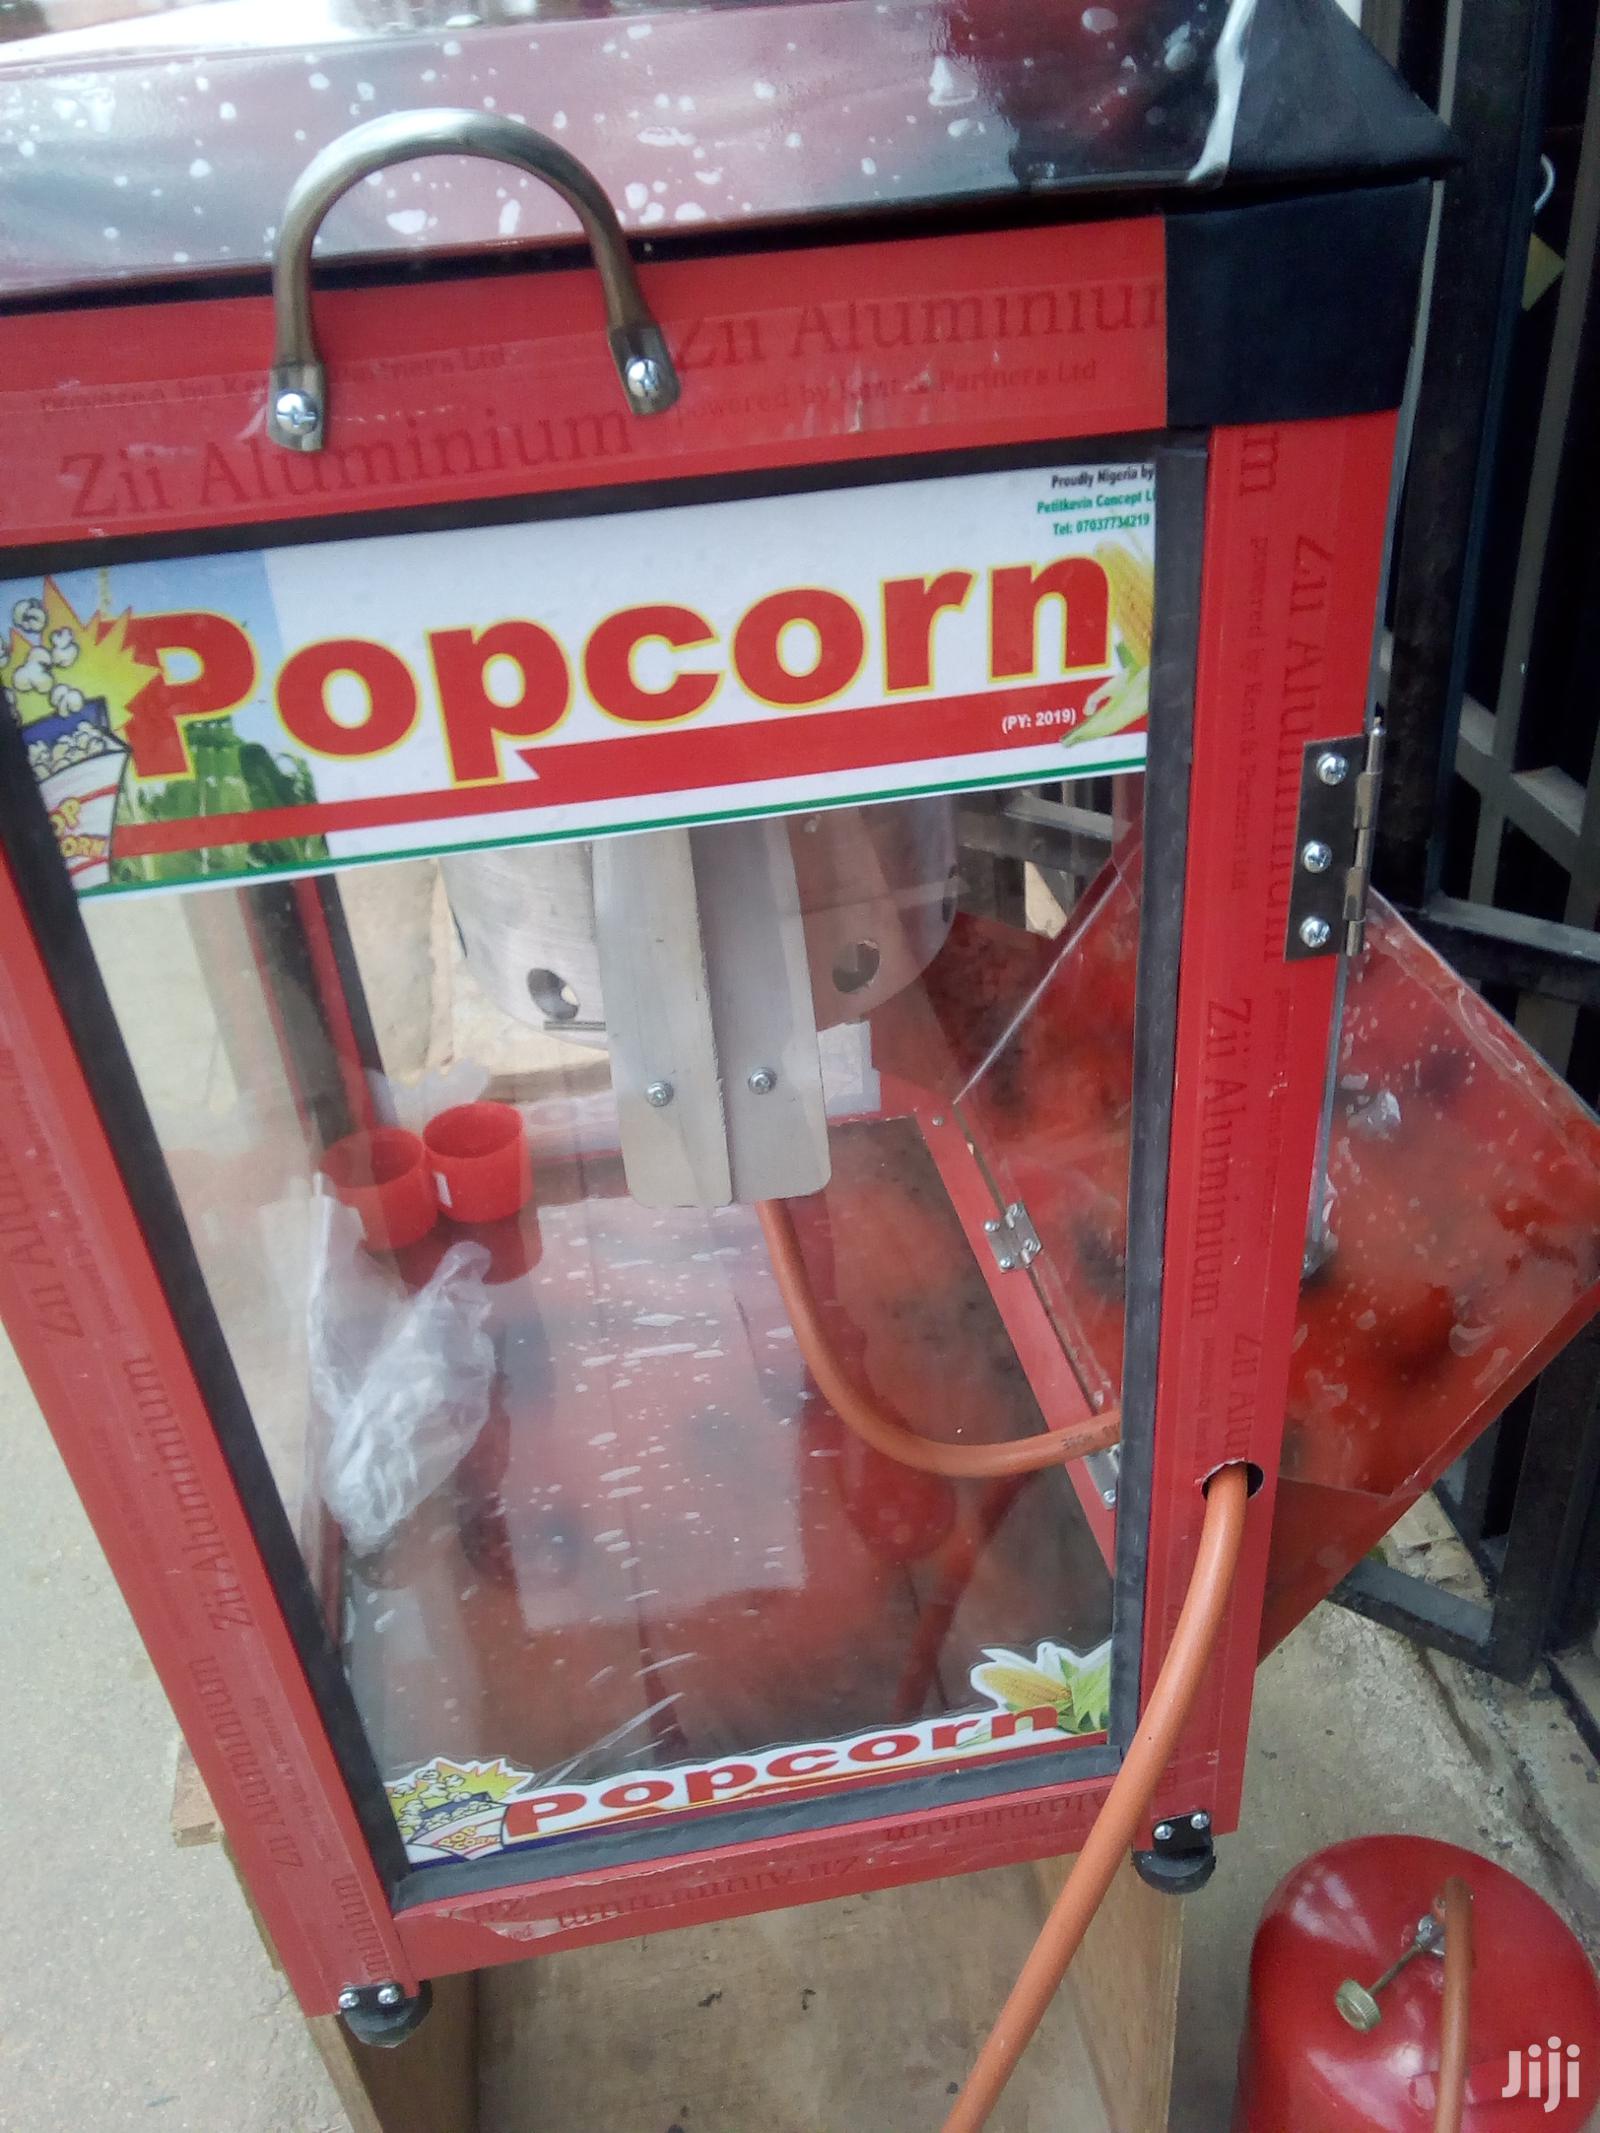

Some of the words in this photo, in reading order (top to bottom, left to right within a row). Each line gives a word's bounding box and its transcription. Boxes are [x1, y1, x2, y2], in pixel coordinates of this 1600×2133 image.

[1053, 522, 1073, 536] Tel:
[101, 554, 1112, 788] Popcorn
[1002, 714, 1032, 735] (PY:
[1035, 708, 1077, 727] 2019)
[505, 1704, 1059, 1838] Popcorn
